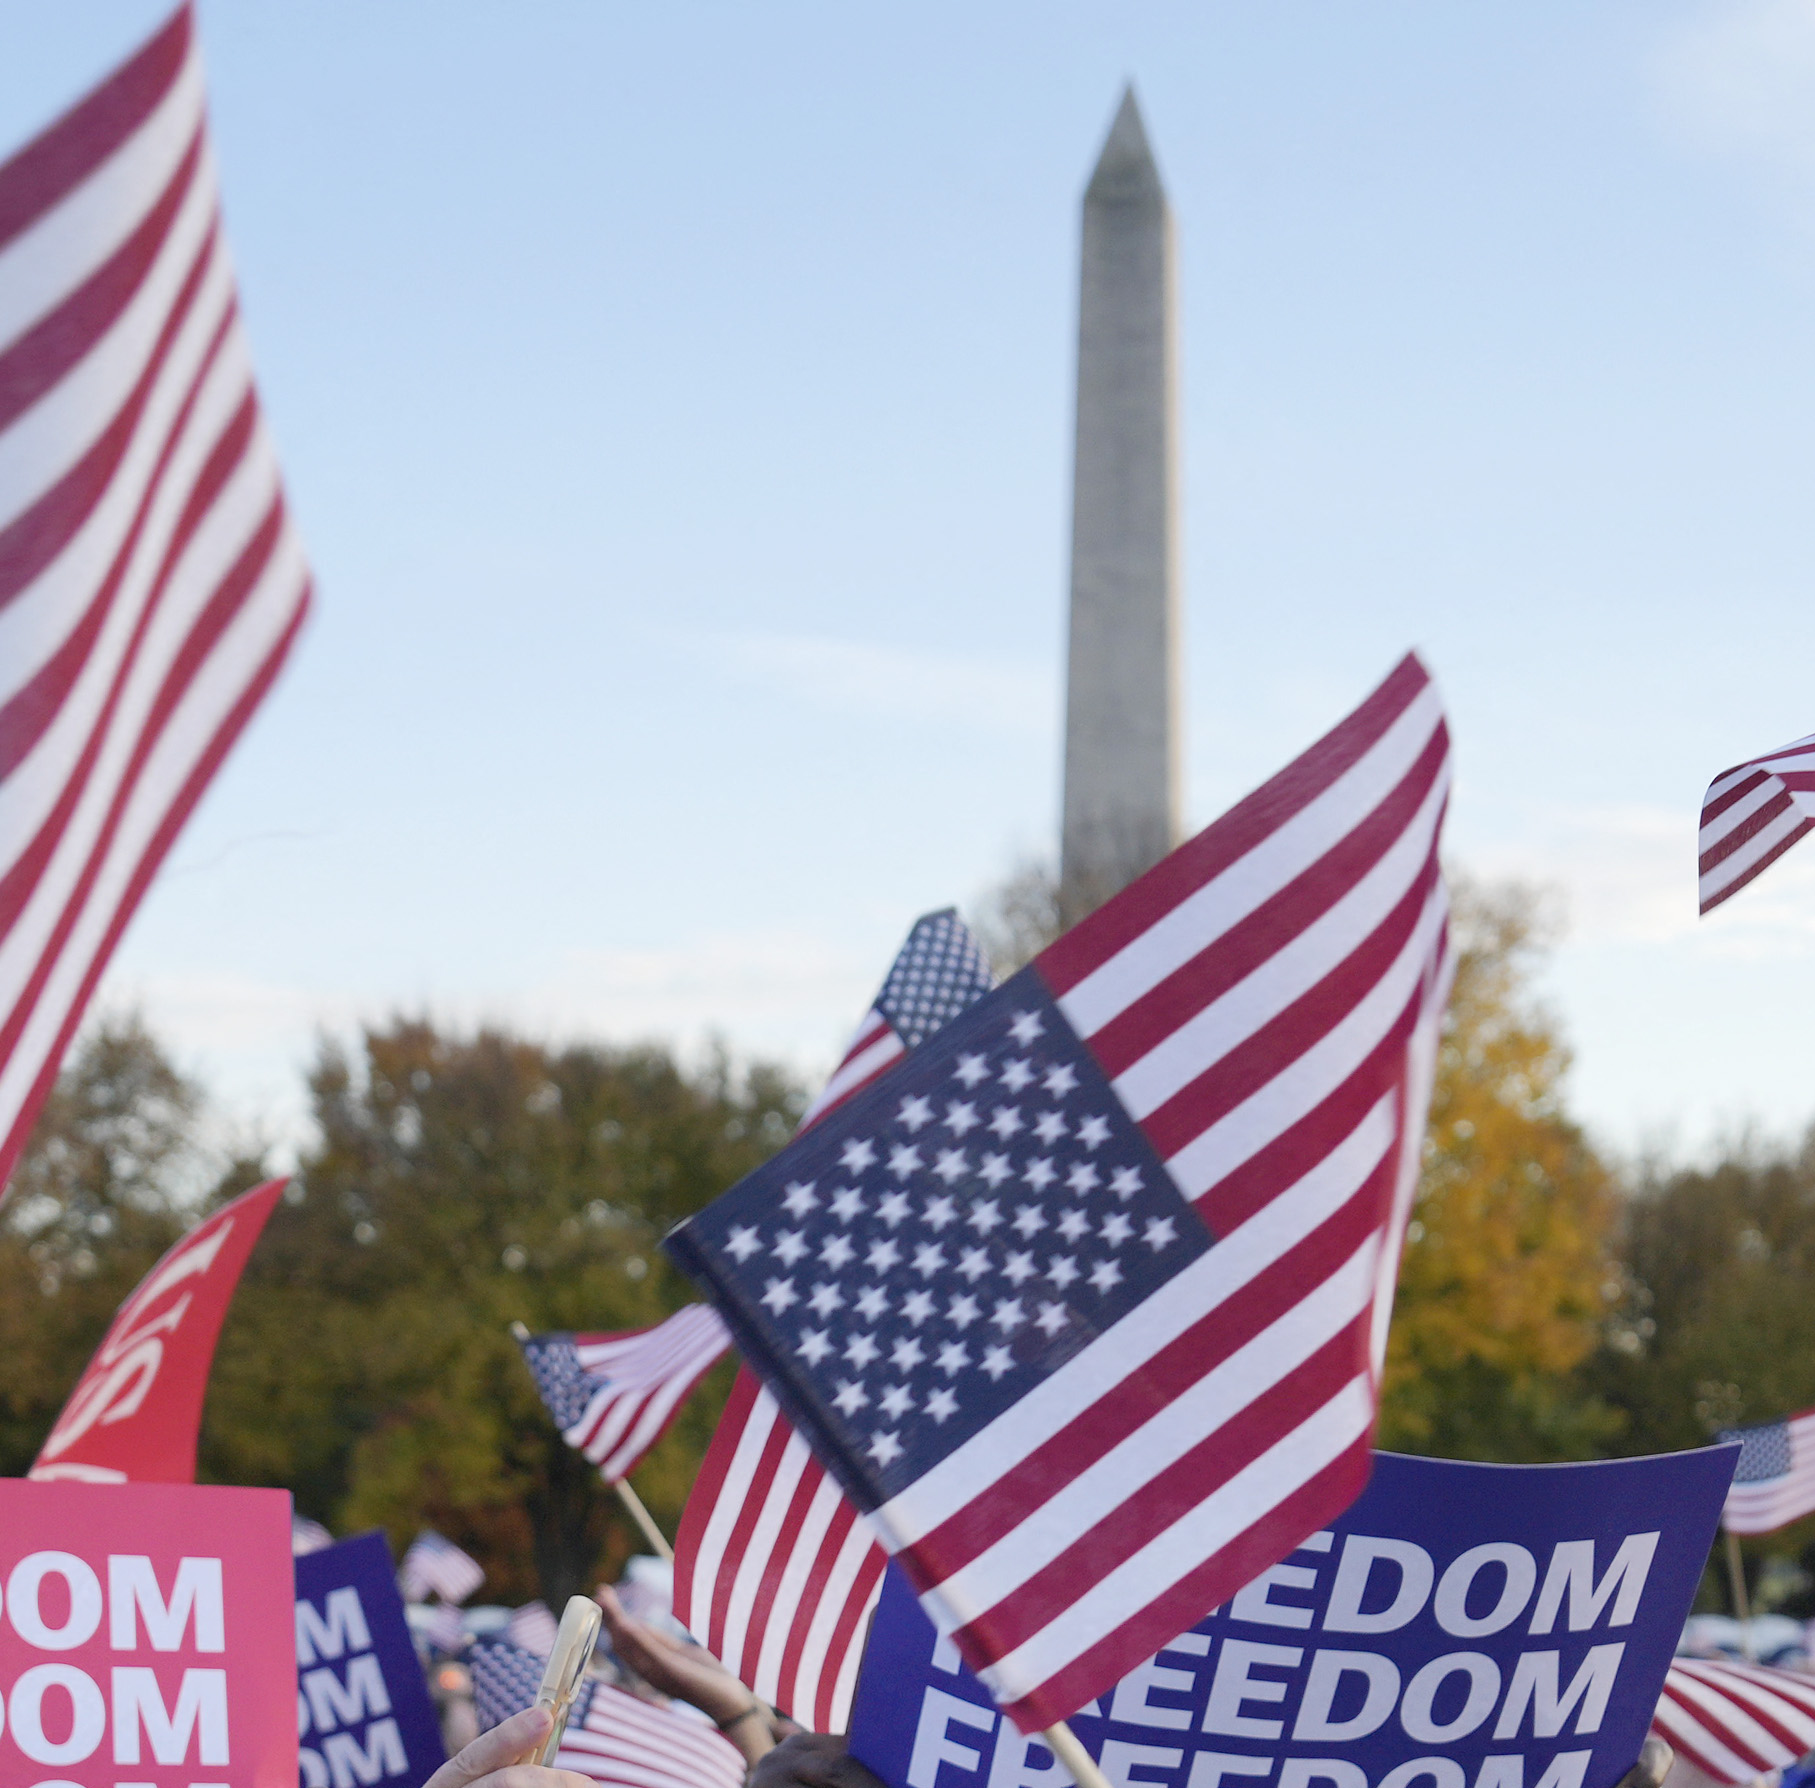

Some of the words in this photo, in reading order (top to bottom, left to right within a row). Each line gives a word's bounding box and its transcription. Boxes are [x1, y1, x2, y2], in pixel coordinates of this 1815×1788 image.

[28, 1218, 234, 1484] US
[1206, 1530, 1661, 1638] EDOM
[931, 1630, 1625, 1744] EEDOM
